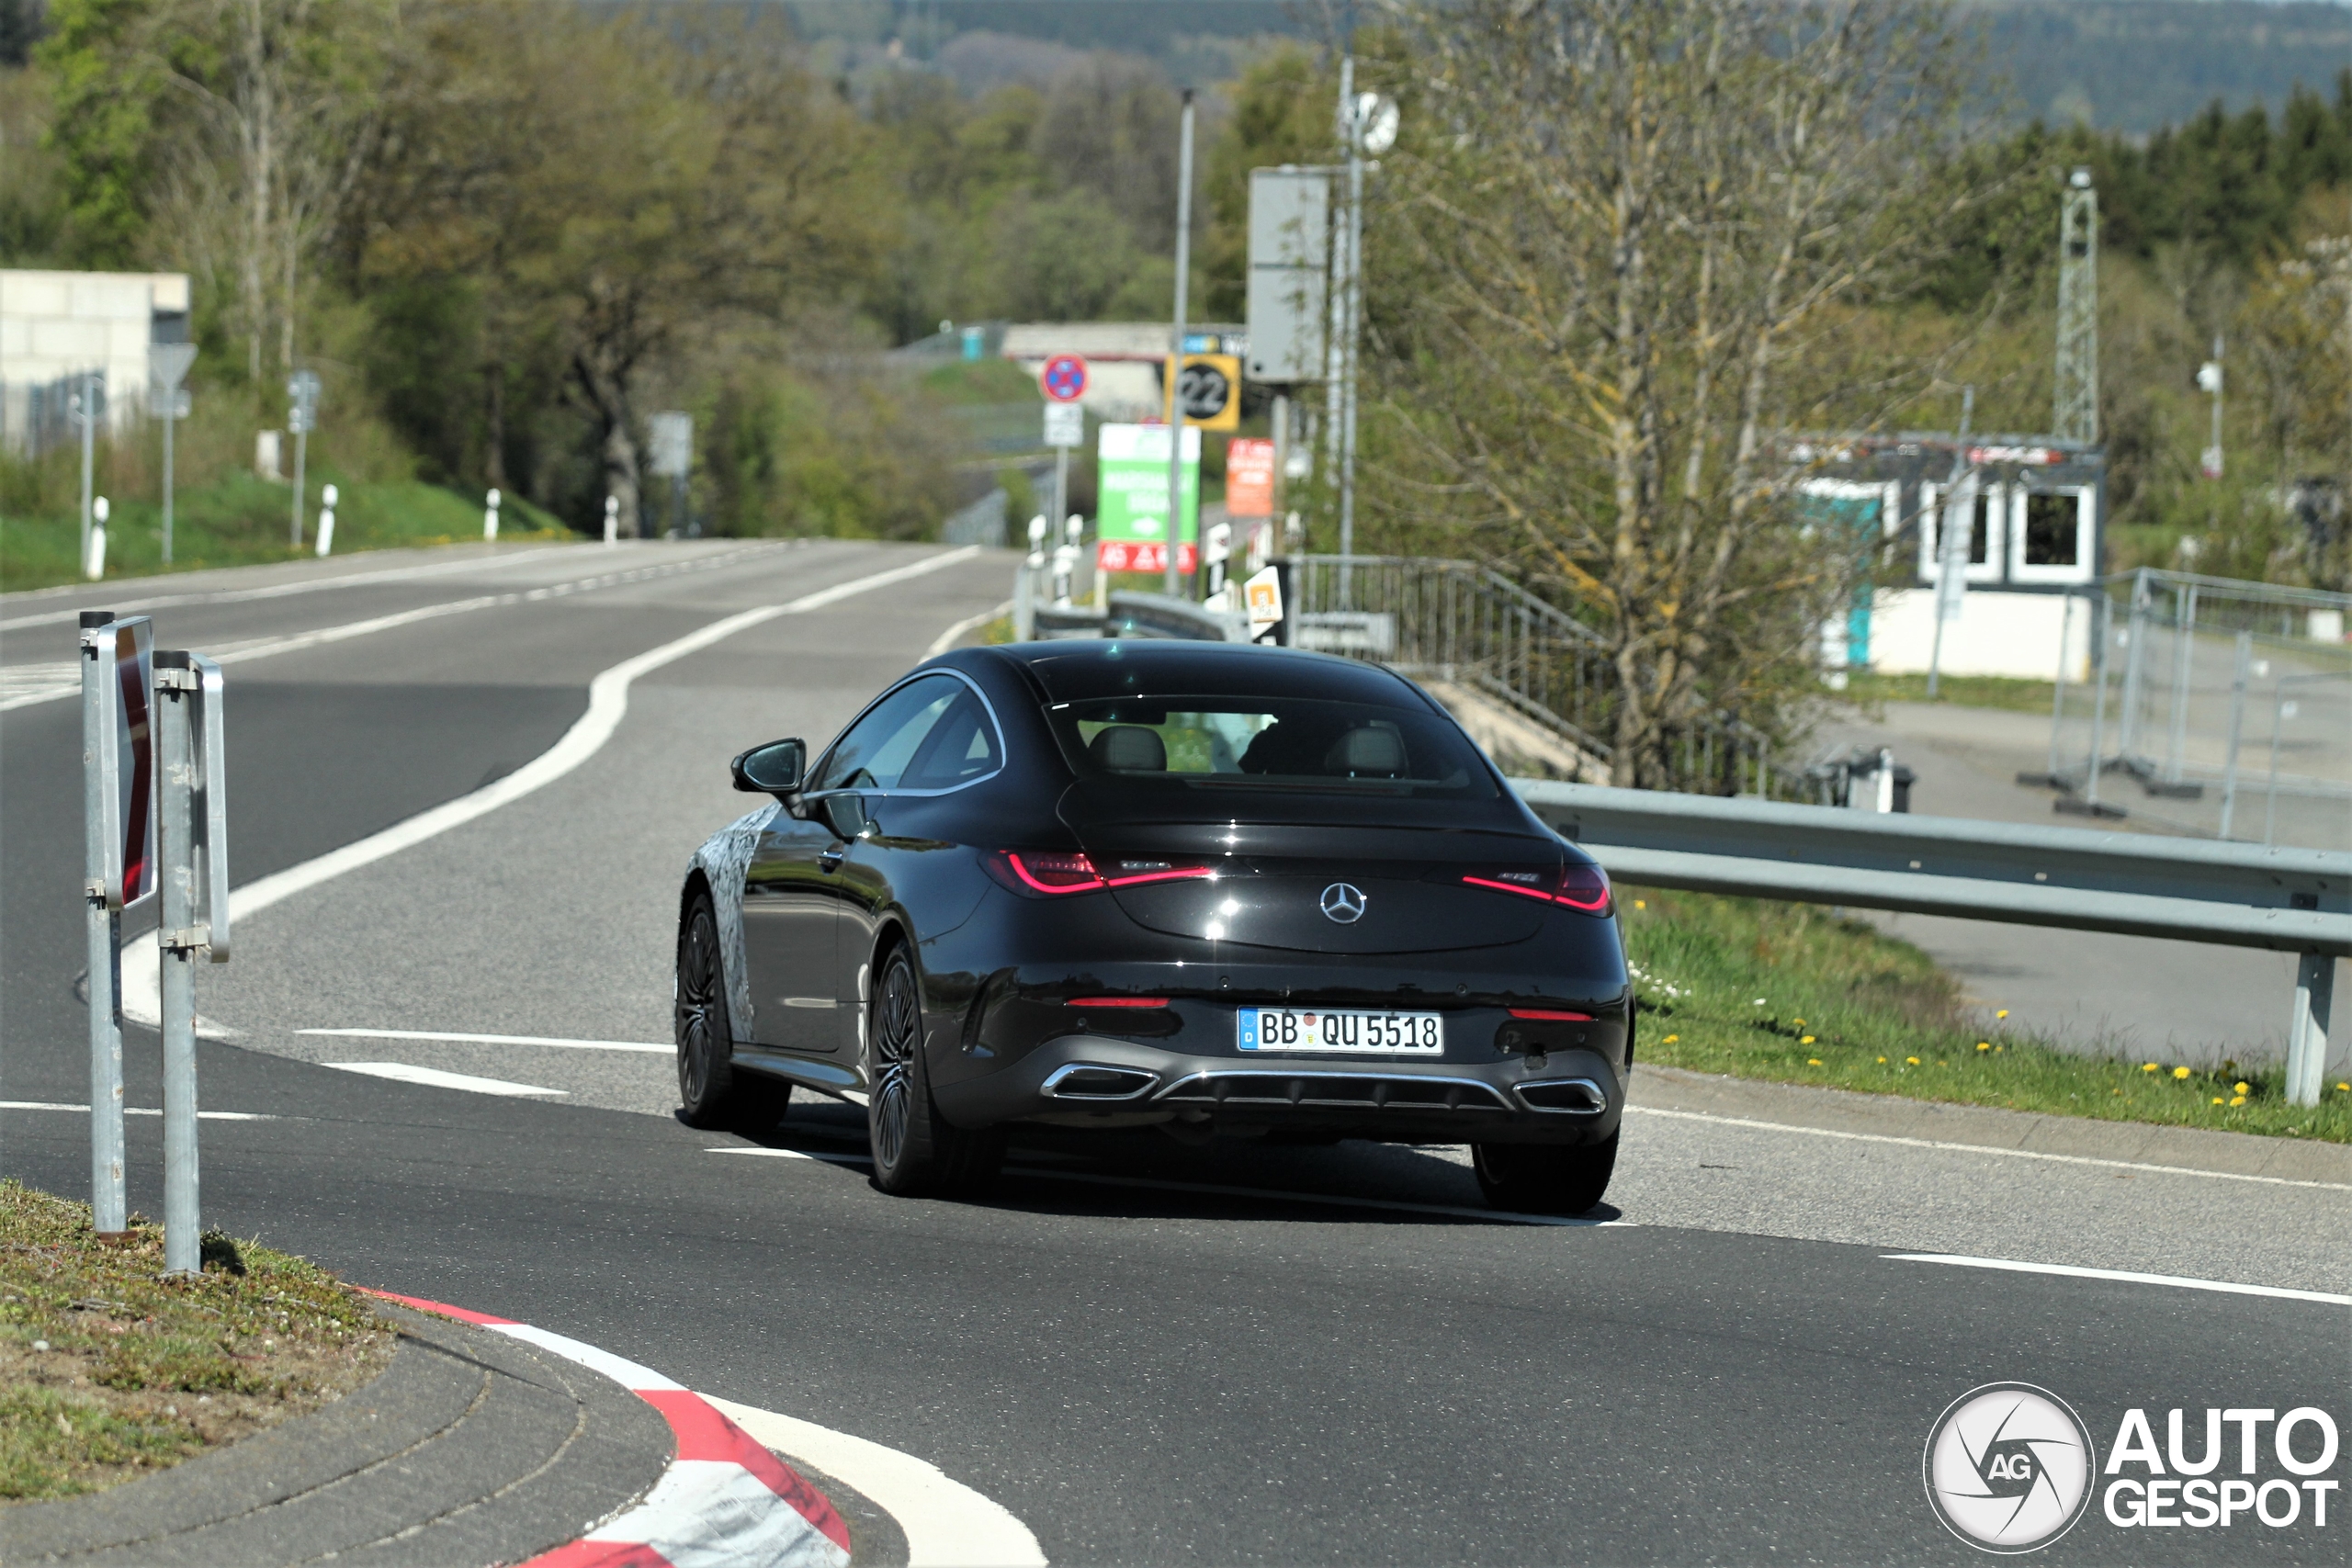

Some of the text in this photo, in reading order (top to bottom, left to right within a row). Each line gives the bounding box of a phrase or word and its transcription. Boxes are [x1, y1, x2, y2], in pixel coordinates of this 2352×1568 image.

[1180, 370, 1225, 412] 22
[1244, 1032, 1253, 1043] D
[1261, 1013, 1298, 1044] BB
[1322, 1014, 1359, 1046] QU
[1367, 1016, 1438, 1048] 5518
